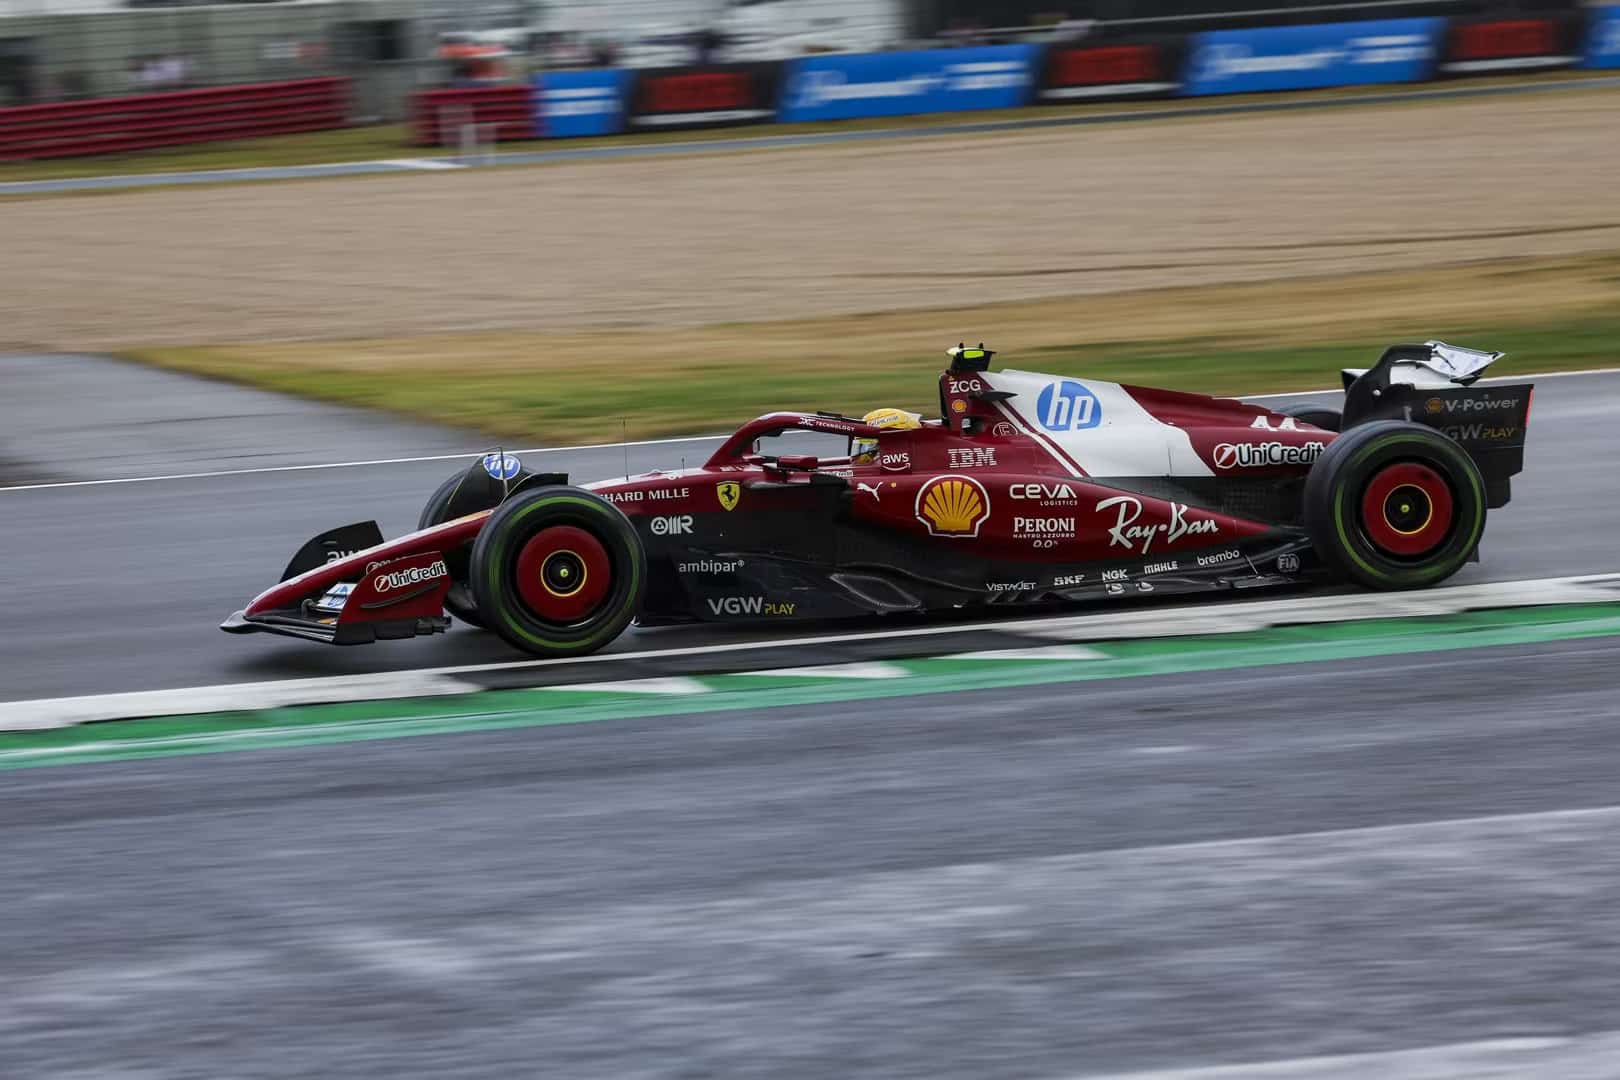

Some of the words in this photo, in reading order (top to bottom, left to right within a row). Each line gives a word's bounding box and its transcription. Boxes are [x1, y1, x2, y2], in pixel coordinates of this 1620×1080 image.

[949, 379, 981, 394] ZCG
[1445, 393, 1520, 412] V-Power
[815, 420, 855, 431] TECHNOLOGY
[882, 452, 911, 465] aws
[948, 447, 998, 468] IBM
[1234, 443, 1325, 466] UniCredit
[600, 491, 643, 503] HARD
[648, 487, 690, 500] MILLE
[1013, 517, 1076, 533] PERONI
[1197, 549, 1240, 567] brembo
[1278, 555, 1298, 570] FIA
[389, 561, 447, 588] UniCredit
[1101, 568, 1129, 581] NGK
[1143, 560, 1179, 575] MAHLE
[1053, 574, 1086, 586] SKF
[707, 596, 763, 616] VGW
[764, 603, 797, 616] PLAY
